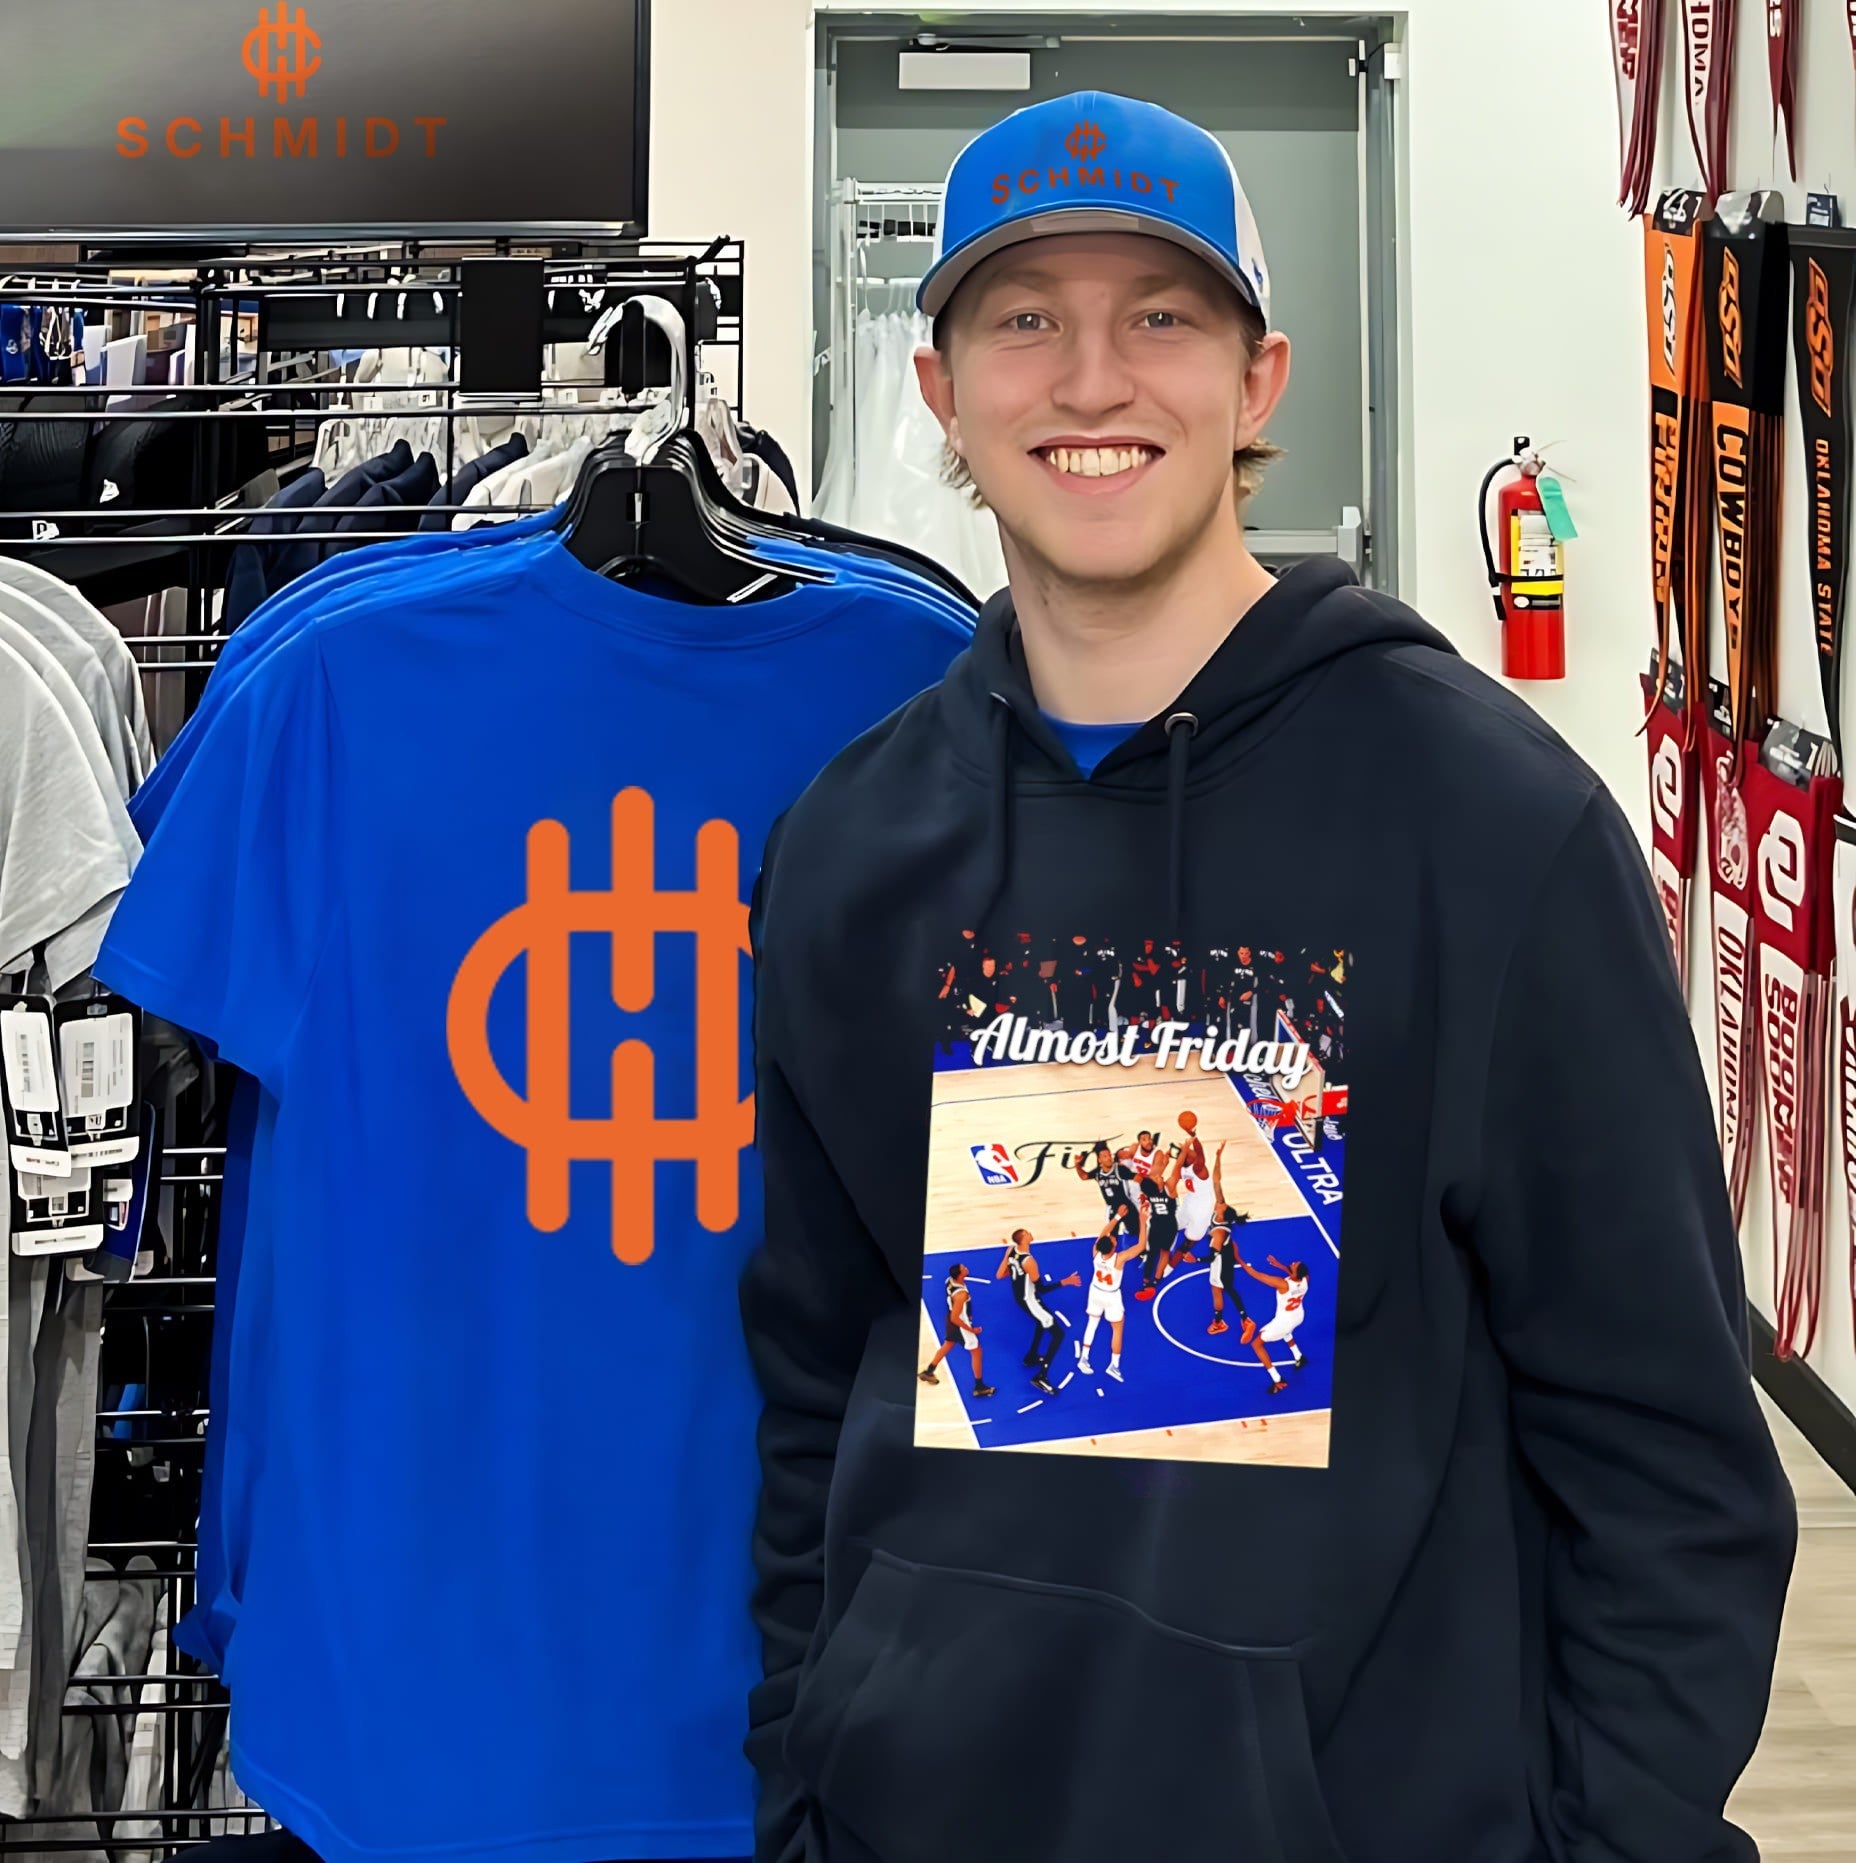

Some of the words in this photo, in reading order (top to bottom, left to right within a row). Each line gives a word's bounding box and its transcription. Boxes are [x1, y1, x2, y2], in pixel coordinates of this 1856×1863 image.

[116, 116, 447, 158] SCHMIDT
[991, 166, 1180, 205] SCHMIDT
[1815, 438, 1832, 570] OKLAHOMA
[970, 1013, 1139, 1066] Almost
[1150, 1021, 1311, 1089] Friday
[1718, 926, 1745, 1144] OKLAHOMA
[1282, 1132, 1344, 1206] ULTRA
